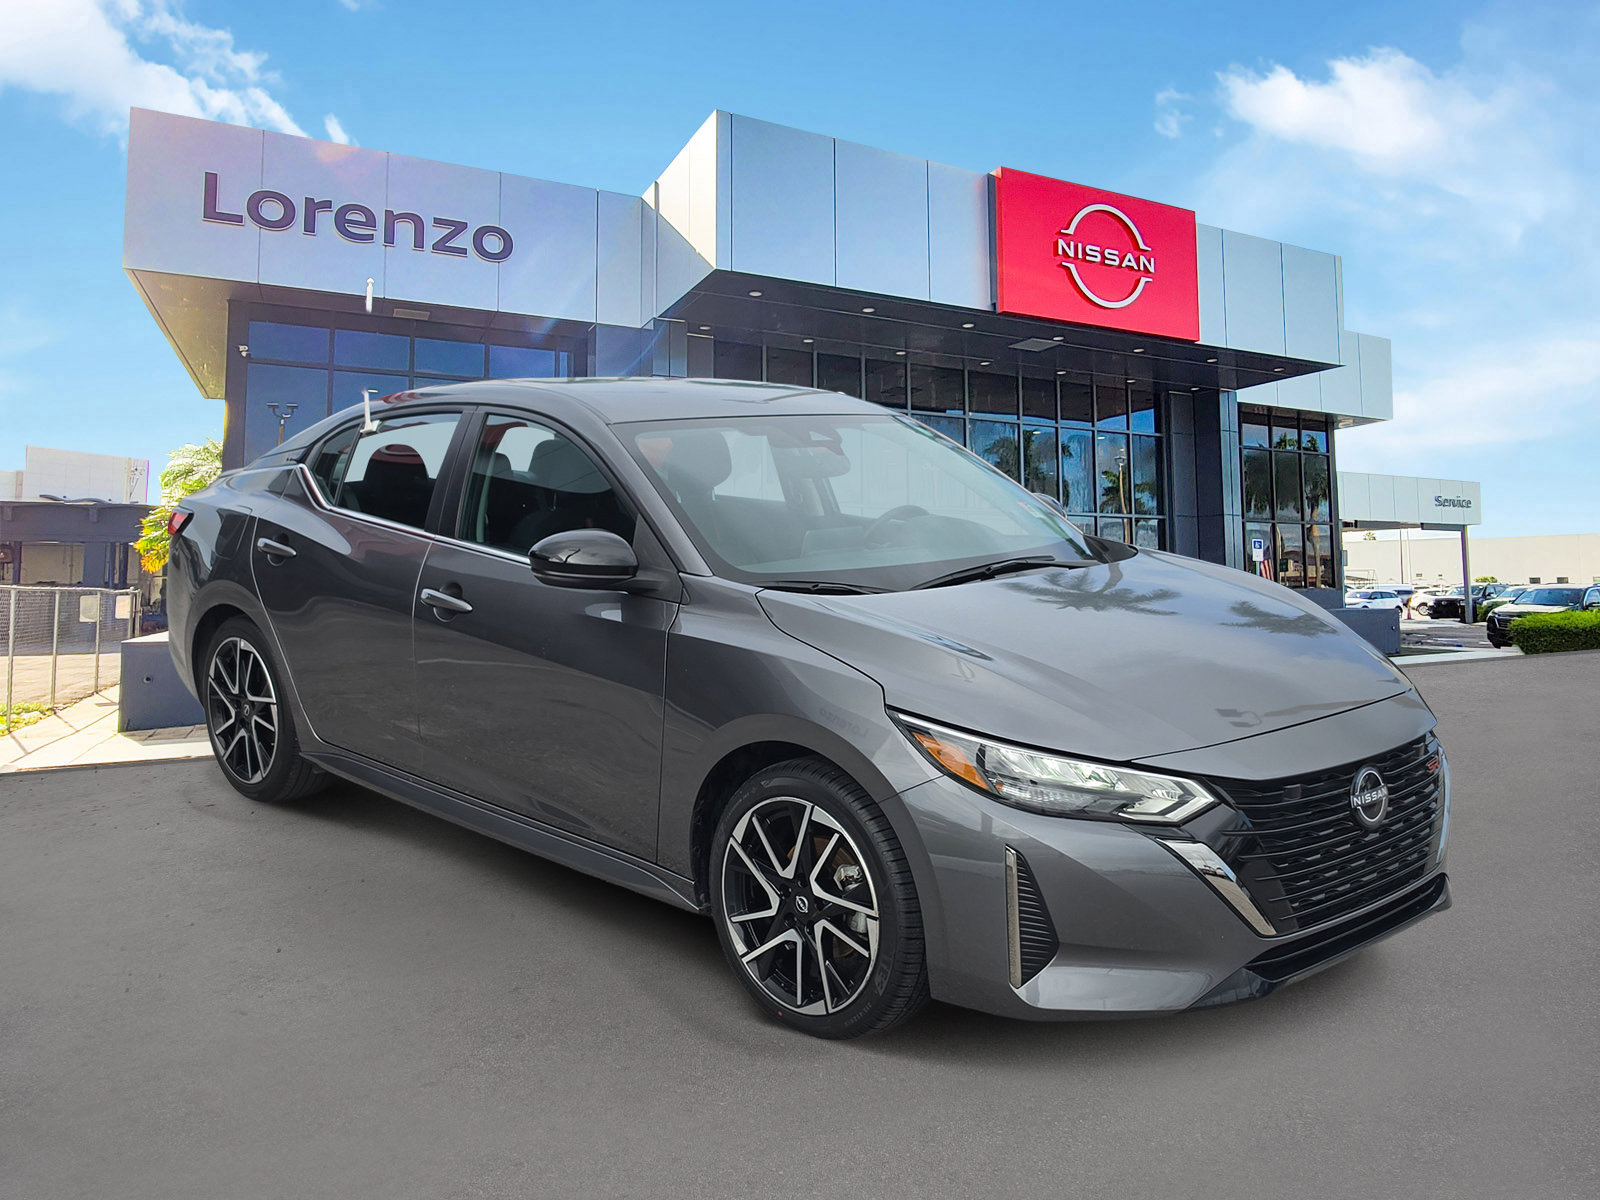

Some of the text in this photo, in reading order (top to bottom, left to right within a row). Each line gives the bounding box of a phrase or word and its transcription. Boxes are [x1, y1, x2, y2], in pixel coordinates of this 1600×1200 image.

[202, 171, 514, 262] Lorenzo
[1057, 238, 1155, 273] NISSAN
[1434, 495, 1472, 508] Service
[1353, 787, 1387, 806] NISSAN
